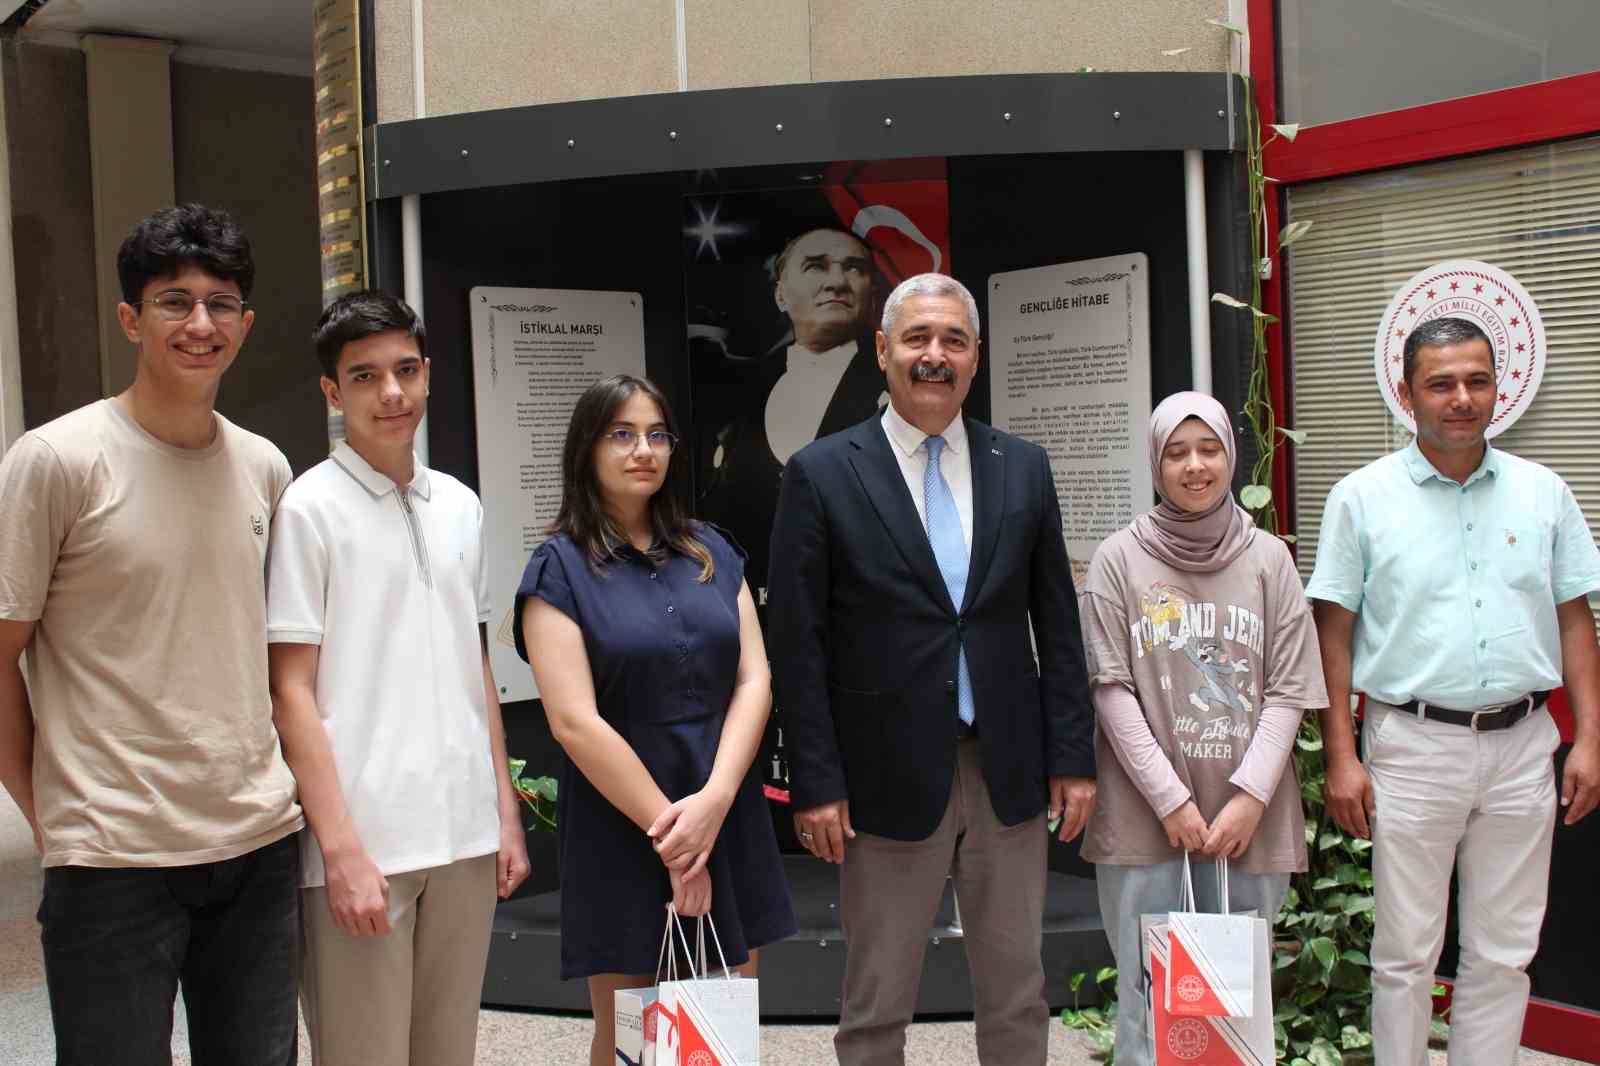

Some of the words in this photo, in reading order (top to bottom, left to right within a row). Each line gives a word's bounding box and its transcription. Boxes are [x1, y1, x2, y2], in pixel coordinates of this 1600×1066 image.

[1020, 297, 1069, 314] GENÇLİĞE
[1071, 293, 1110, 308] HİTABE
[520, 321, 568, 335] İSTİKLAL
[570, 323, 603, 336] MARŞI
[1452, 301, 1481, 313] MİLLİ
[1481, 310, 1505, 346] EĞİTİM
[1130, 615, 1170, 658] TOM
[1178, 602, 1216, 638] AND
[1179, 742, 1232, 759] MAKER
